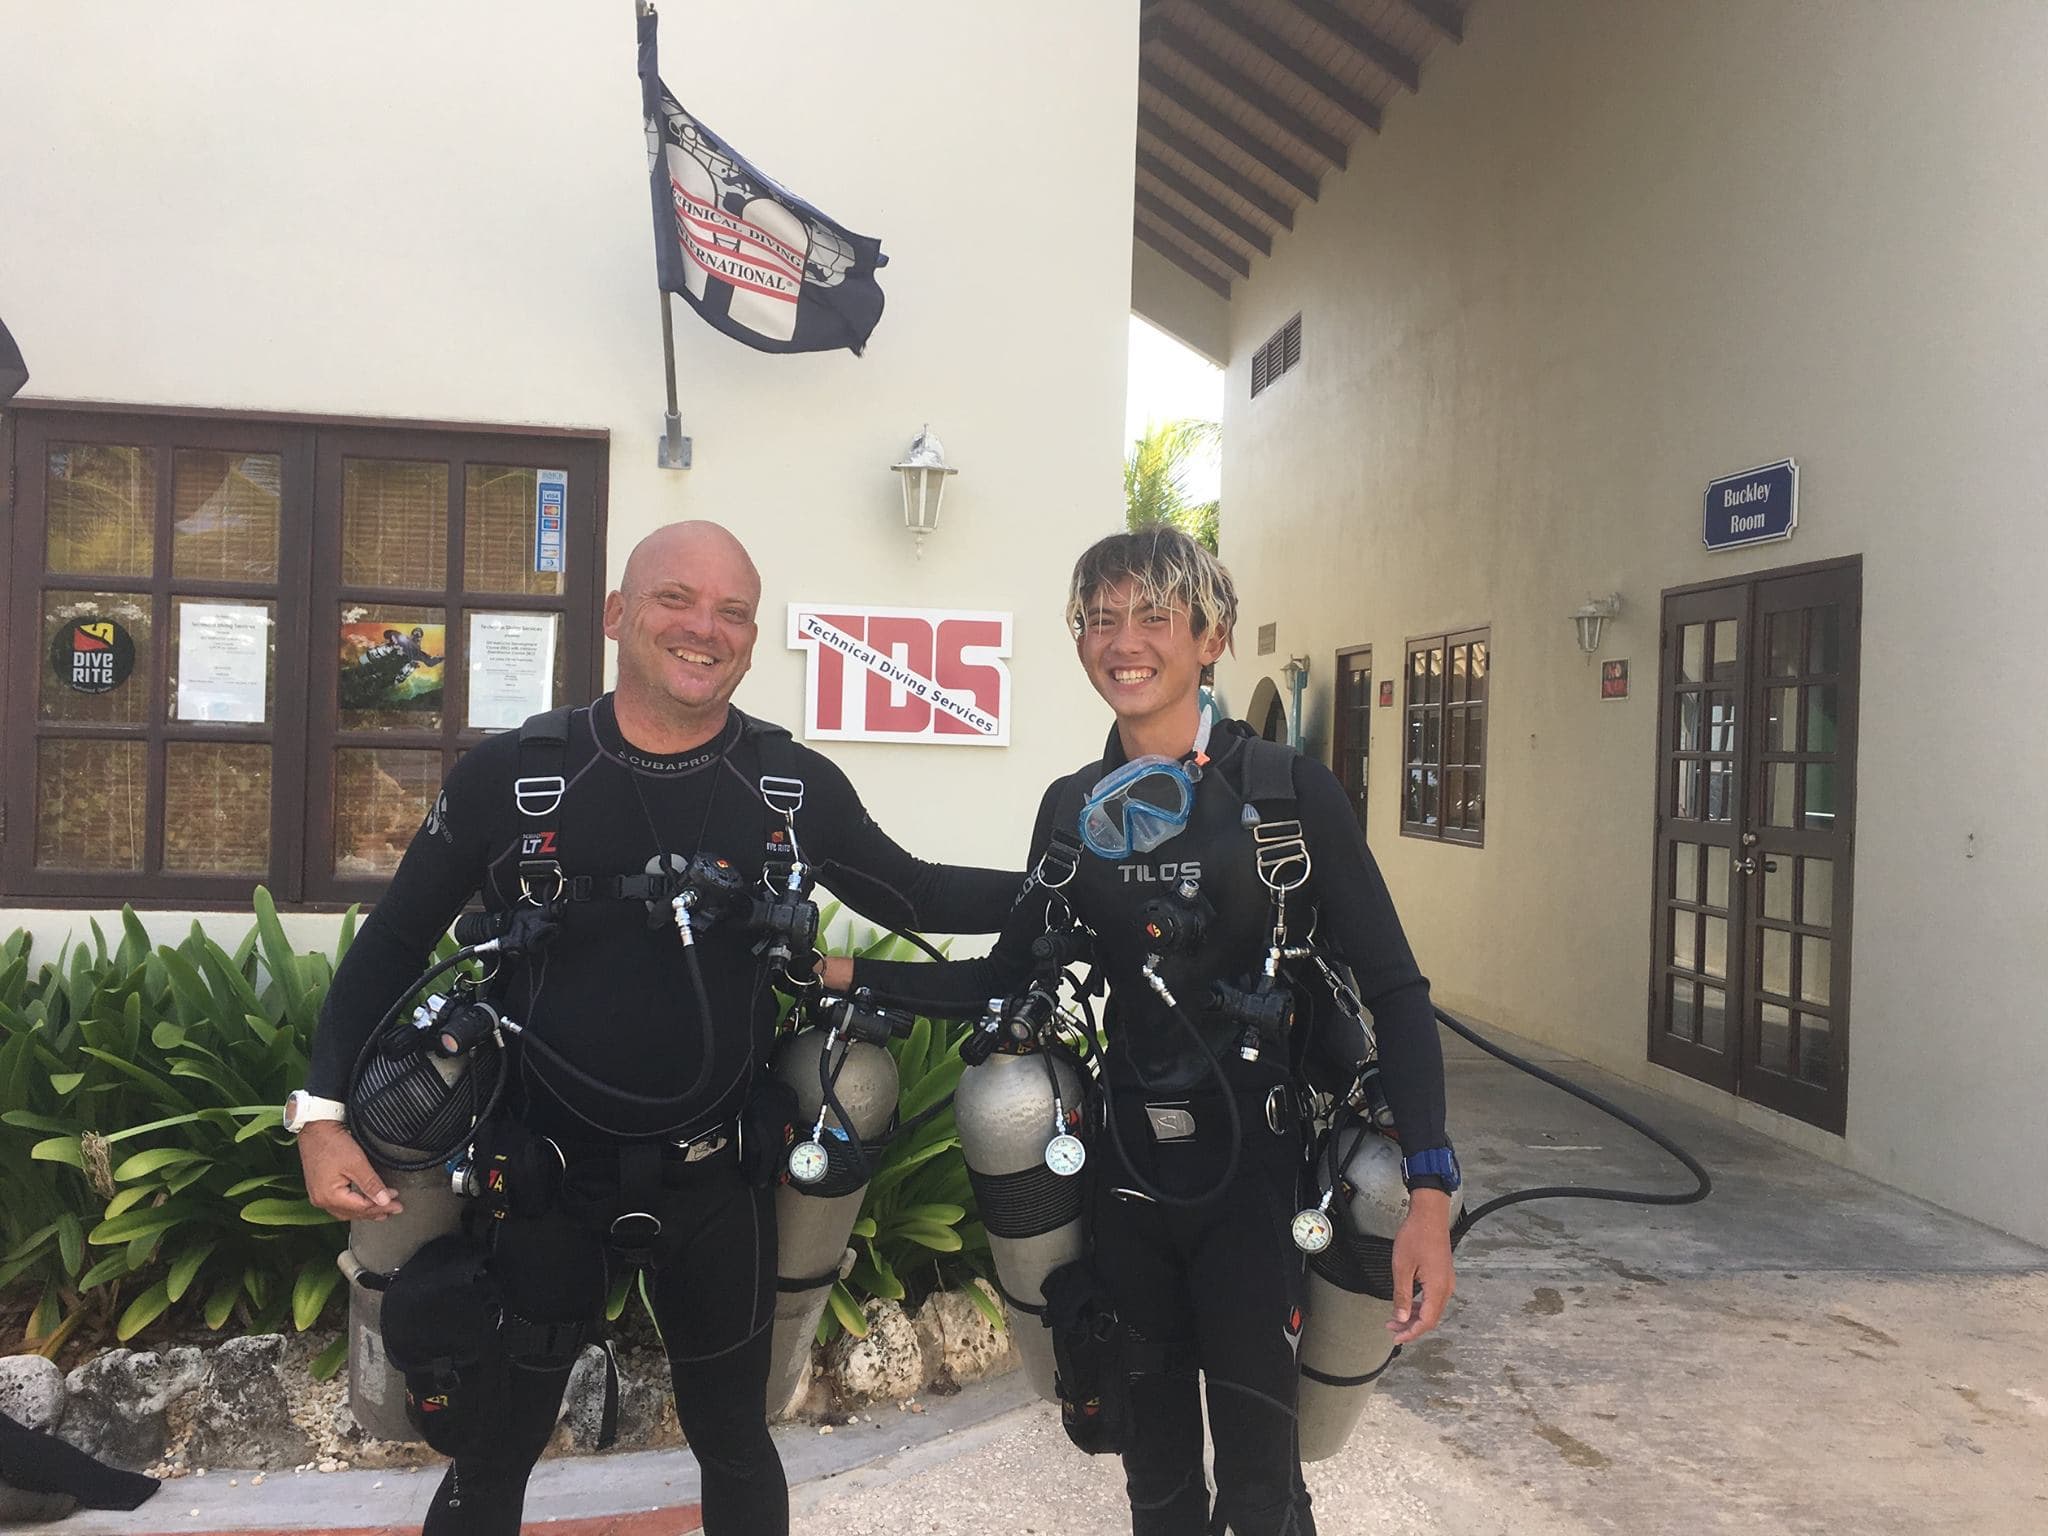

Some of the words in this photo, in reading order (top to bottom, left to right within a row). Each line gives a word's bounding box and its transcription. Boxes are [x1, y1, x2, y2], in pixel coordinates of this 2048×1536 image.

[676, 223, 787, 291] NTERNATIONAL
[749, 229, 802, 267] DIVING
[1723, 482, 1771, 508] Buckley
[1730, 513, 1765, 534] Room
[73, 651, 113, 668] DIVE
[72, 667, 113, 684] RITE
[798, 613, 1003, 736] TDS
[807, 618, 875, 666] Technical
[879, 661, 927, 696] Diving
[930, 690, 993, 732] Services
[618, 751, 710, 770] SCUBAPRO
[1118, 861, 1202, 883] TILOS
